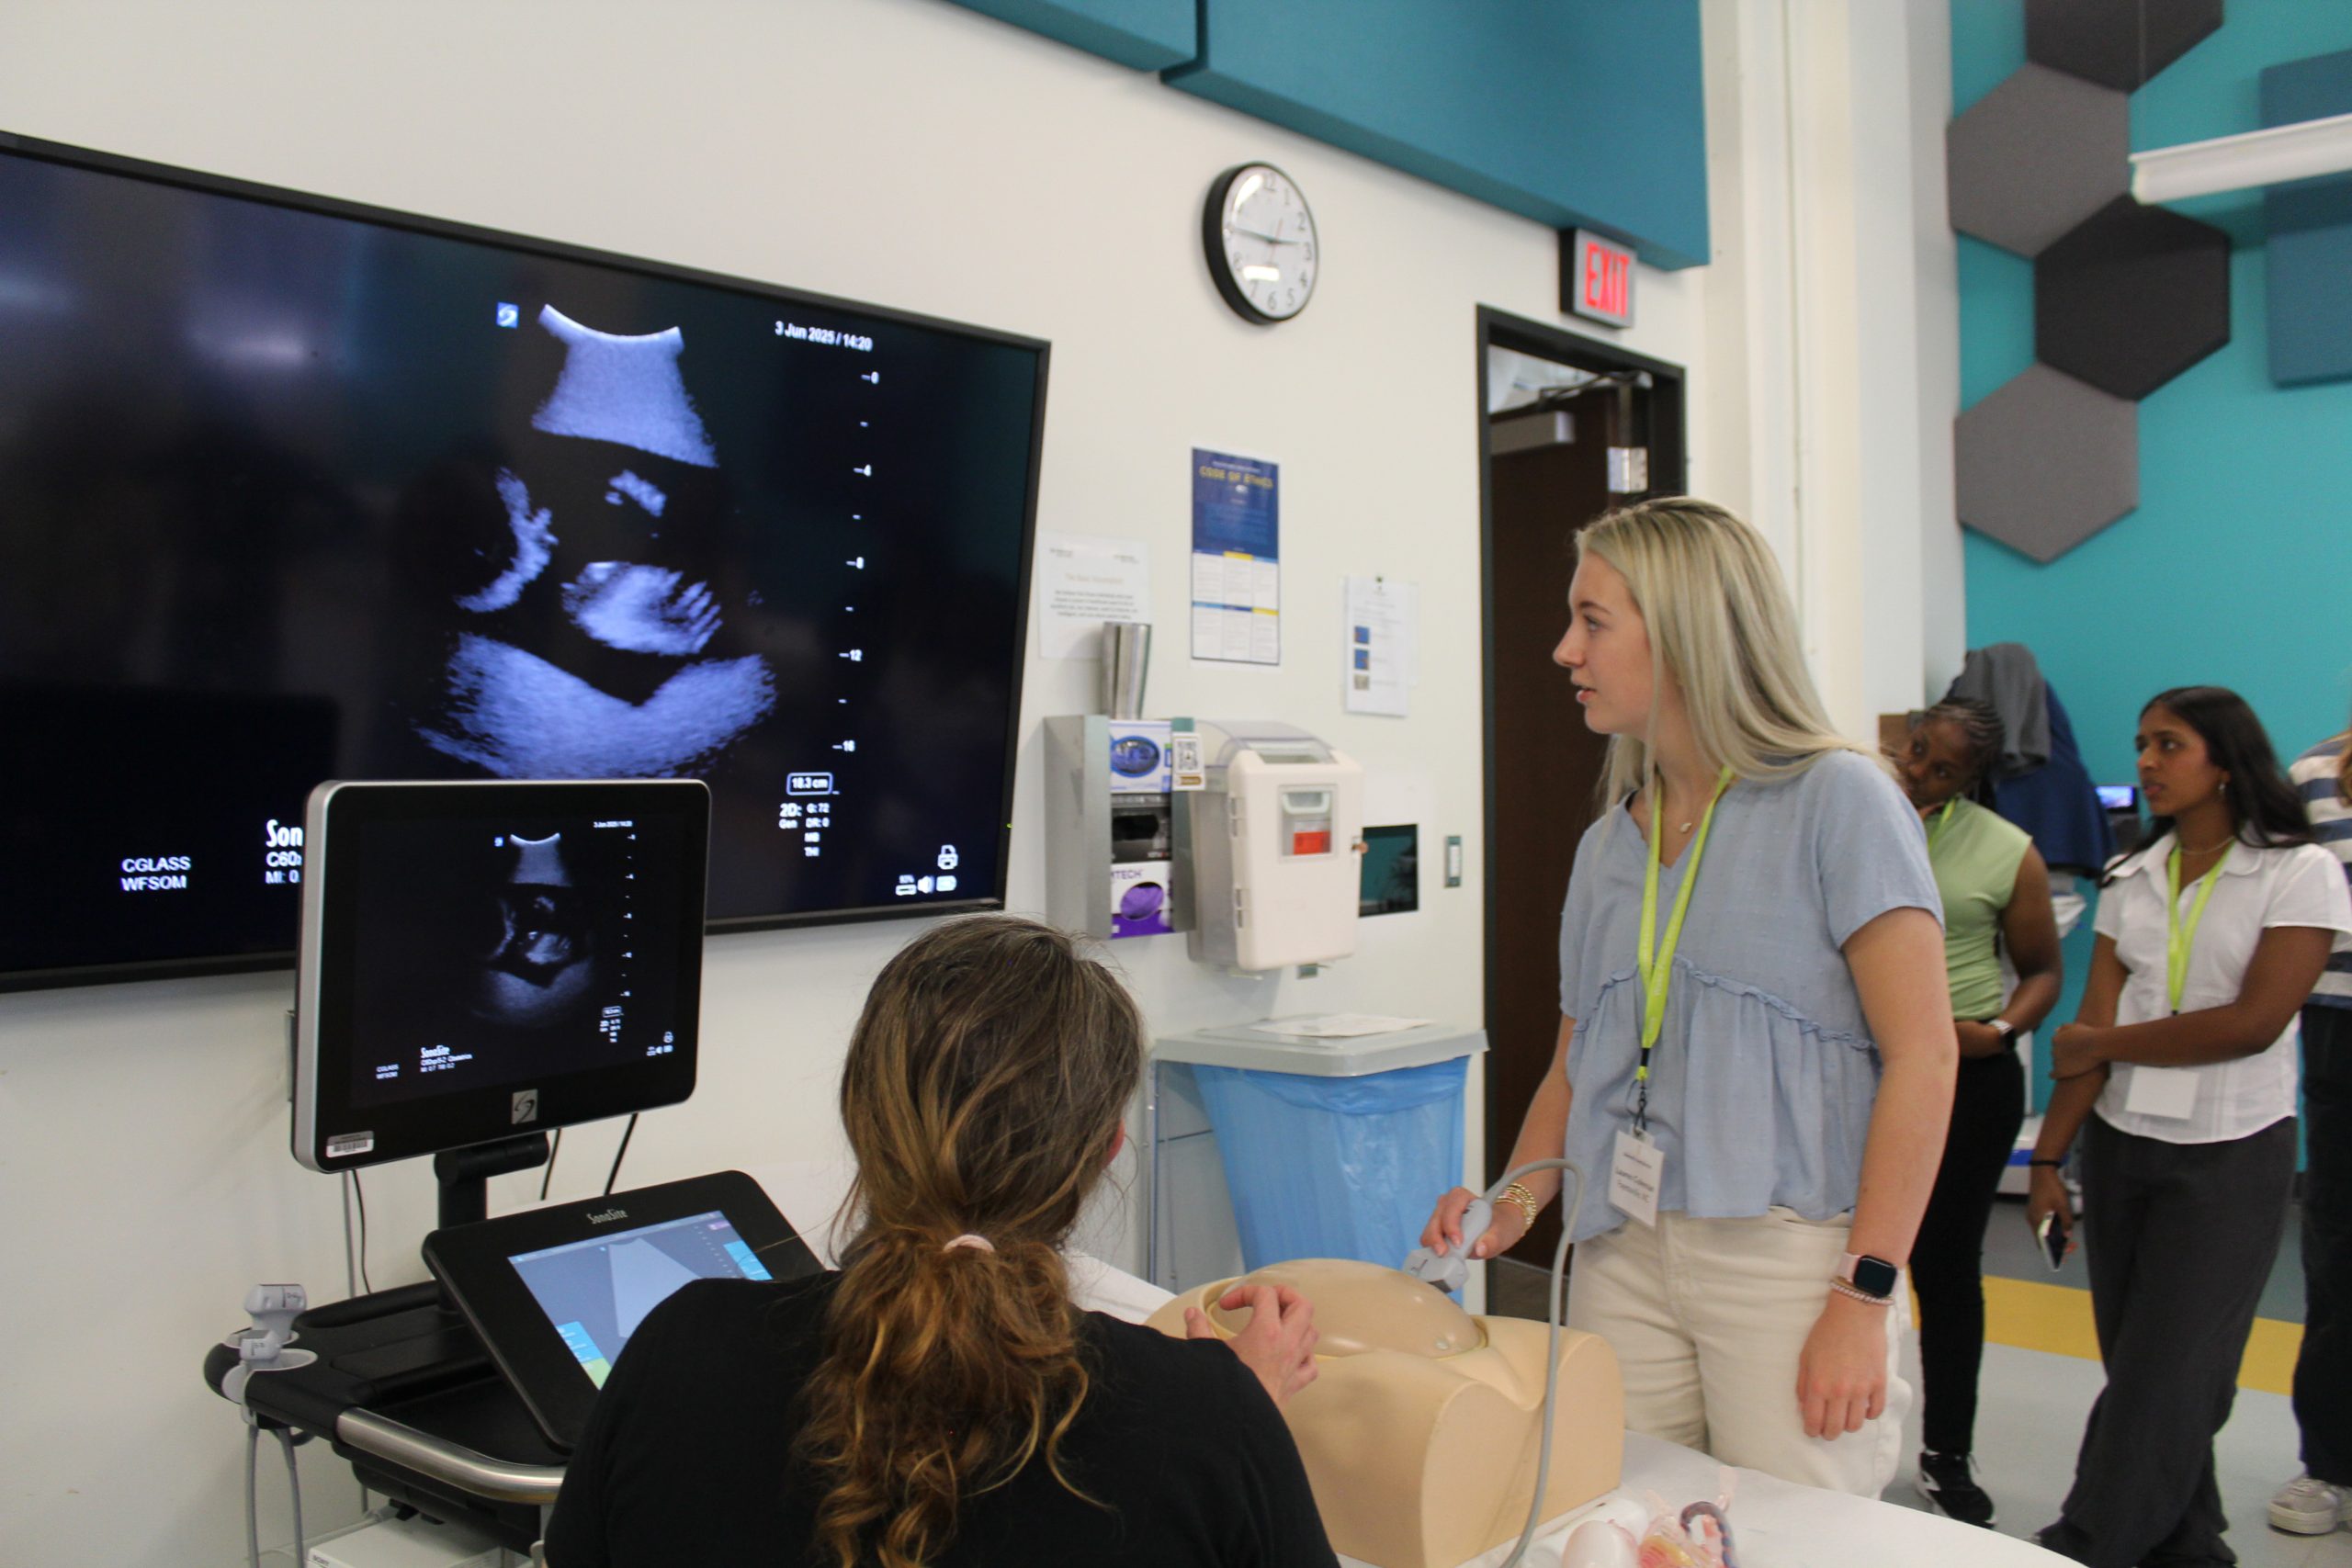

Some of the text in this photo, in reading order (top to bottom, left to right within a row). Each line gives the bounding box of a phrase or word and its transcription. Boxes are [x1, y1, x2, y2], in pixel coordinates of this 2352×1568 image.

[1584, 241, 1630, 319] EXIT
[775, 320, 785, 336] 3
[784, 322, 808, 340] Jun
[808, 326, 836, 345] 2025
[842, 333, 874, 353] 14:20
[120, 856, 192, 874] CGLASS
[120, 875, 187, 891] WFSOM
[585, 1208, 628, 1224] SonoSite
